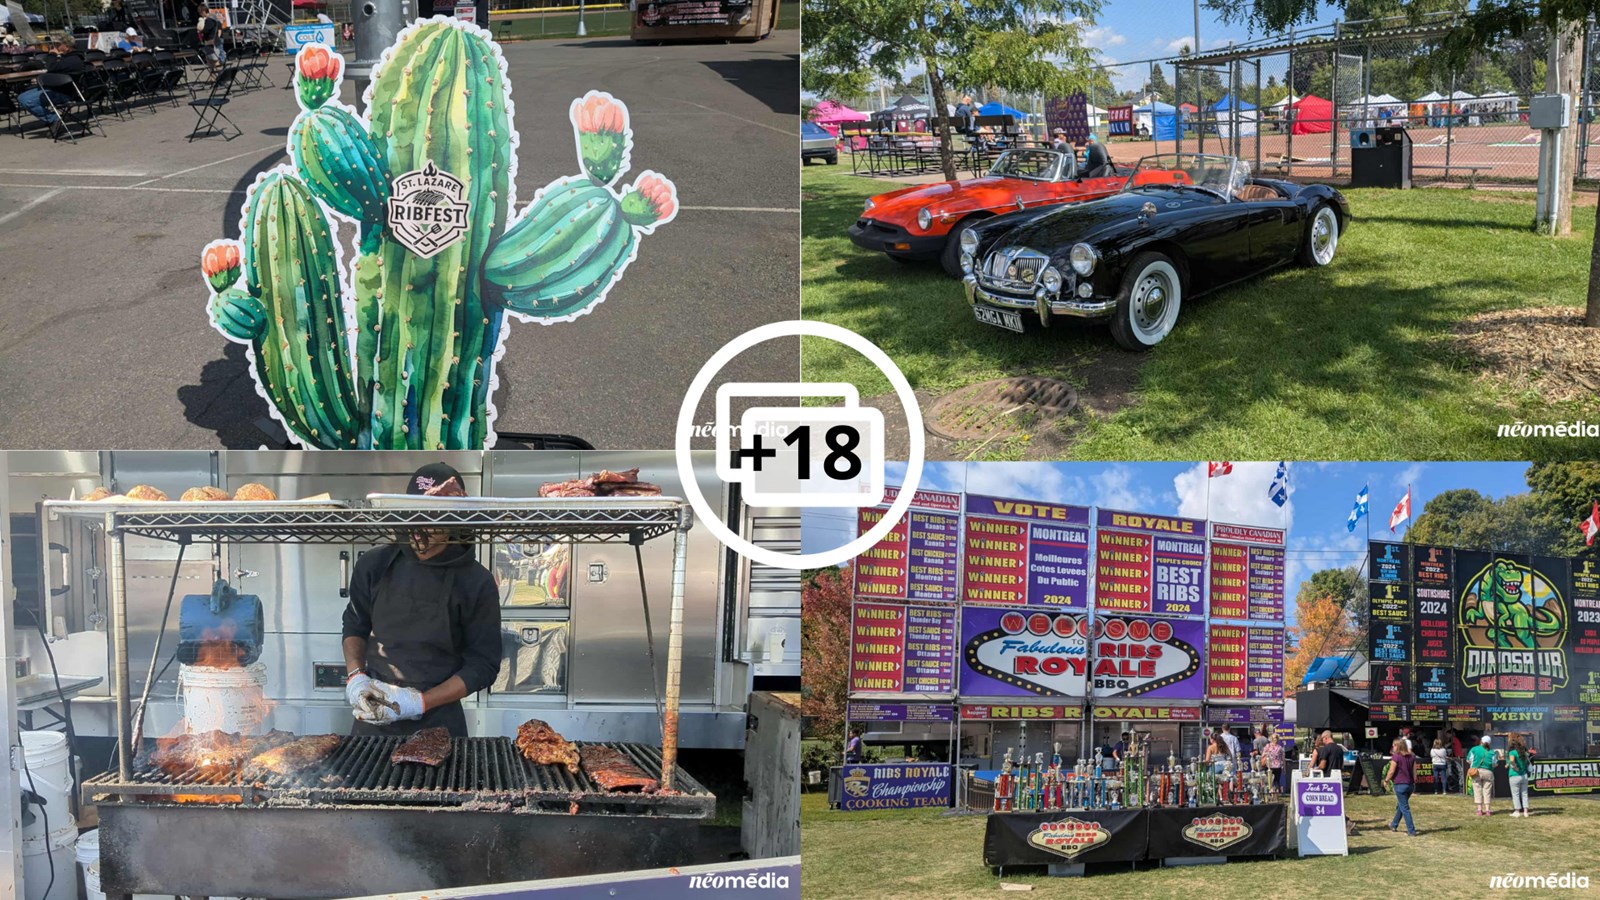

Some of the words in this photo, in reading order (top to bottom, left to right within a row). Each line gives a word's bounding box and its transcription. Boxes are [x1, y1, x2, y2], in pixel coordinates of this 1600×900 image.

[401, 180, 416, 190] ST.
[418, 178, 458, 192] LAZARE
[395, 205, 463, 224] RIBFEST
[993, 500, 1066, 520] VOTE
[1112, 514, 1193, 533] ROYALE
[1032, 528, 1086, 543] MONTREAL
[1157, 540, 1204, 554] MONTREAL
[1035, 554, 1082, 564] Meilleures
[1030, 564, 1056, 574] Cotes
[1057, 566, 1086, 576] Levees
[1156, 566, 1202, 584] BEST
[1038, 576, 1050, 584] Du
[1051, 577, 1080, 586] Public
[1157, 584, 1200, 602] RIBS
[1416, 588, 1450, 599] SOUTHSHORE
[1044, 595, 1072, 604] 2024
[1166, 604, 1190, 612] 2024
[1420, 601, 1448, 614] 2024
[1578, 611, 1600, 622] 2023
[1000, 640, 1086, 655] Fabulous
[1098, 643, 1164, 659] RIBS
[1014, 656, 1157, 677] ROYALE
[1467, 650, 1564, 678] DINOSAUR
[1094, 679, 1129, 689] BBQ
[991, 706, 1055, 718] RIBS
[1064, 707, 1170, 718] ROYALE
[1492, 712, 1543, 720] MENU
[874, 768, 900, 778] RIBS
[906, 767, 949, 778] ROYALE
[872, 778, 945, 798] Championship
[846, 798, 909, 808] COOKING
[913, 797, 948, 806] TEAM
[1316, 806, 1325, 814] $4
